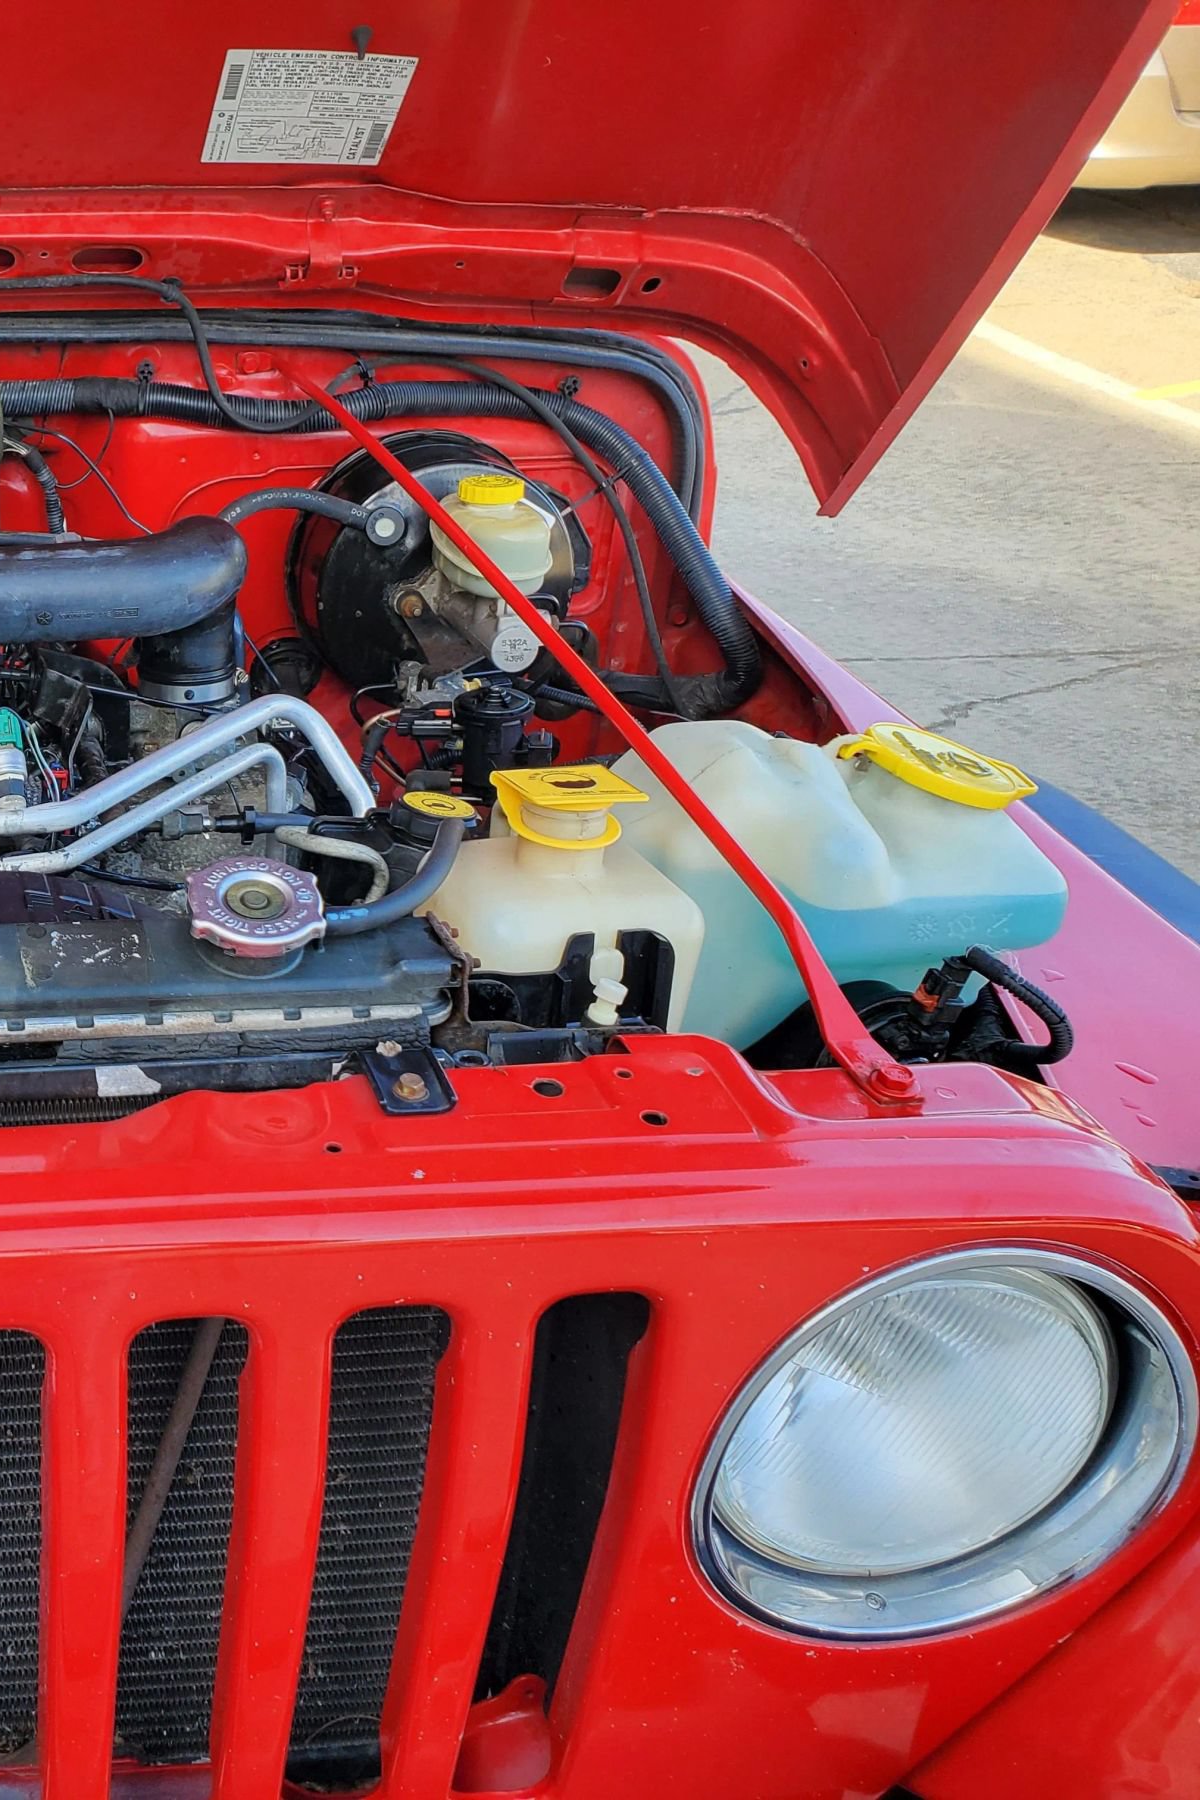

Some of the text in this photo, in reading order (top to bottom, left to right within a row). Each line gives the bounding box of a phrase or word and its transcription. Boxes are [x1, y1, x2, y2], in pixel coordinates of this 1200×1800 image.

[367, 56, 416, 65] INFORMATION
[346, 127, 367, 160] CATALYST
[351, 508, 368, 520] DOT
[202, 861, 314, 903] DO NOT OPEN HOT
[207, 908, 300, 935] KEEP TIGHT
